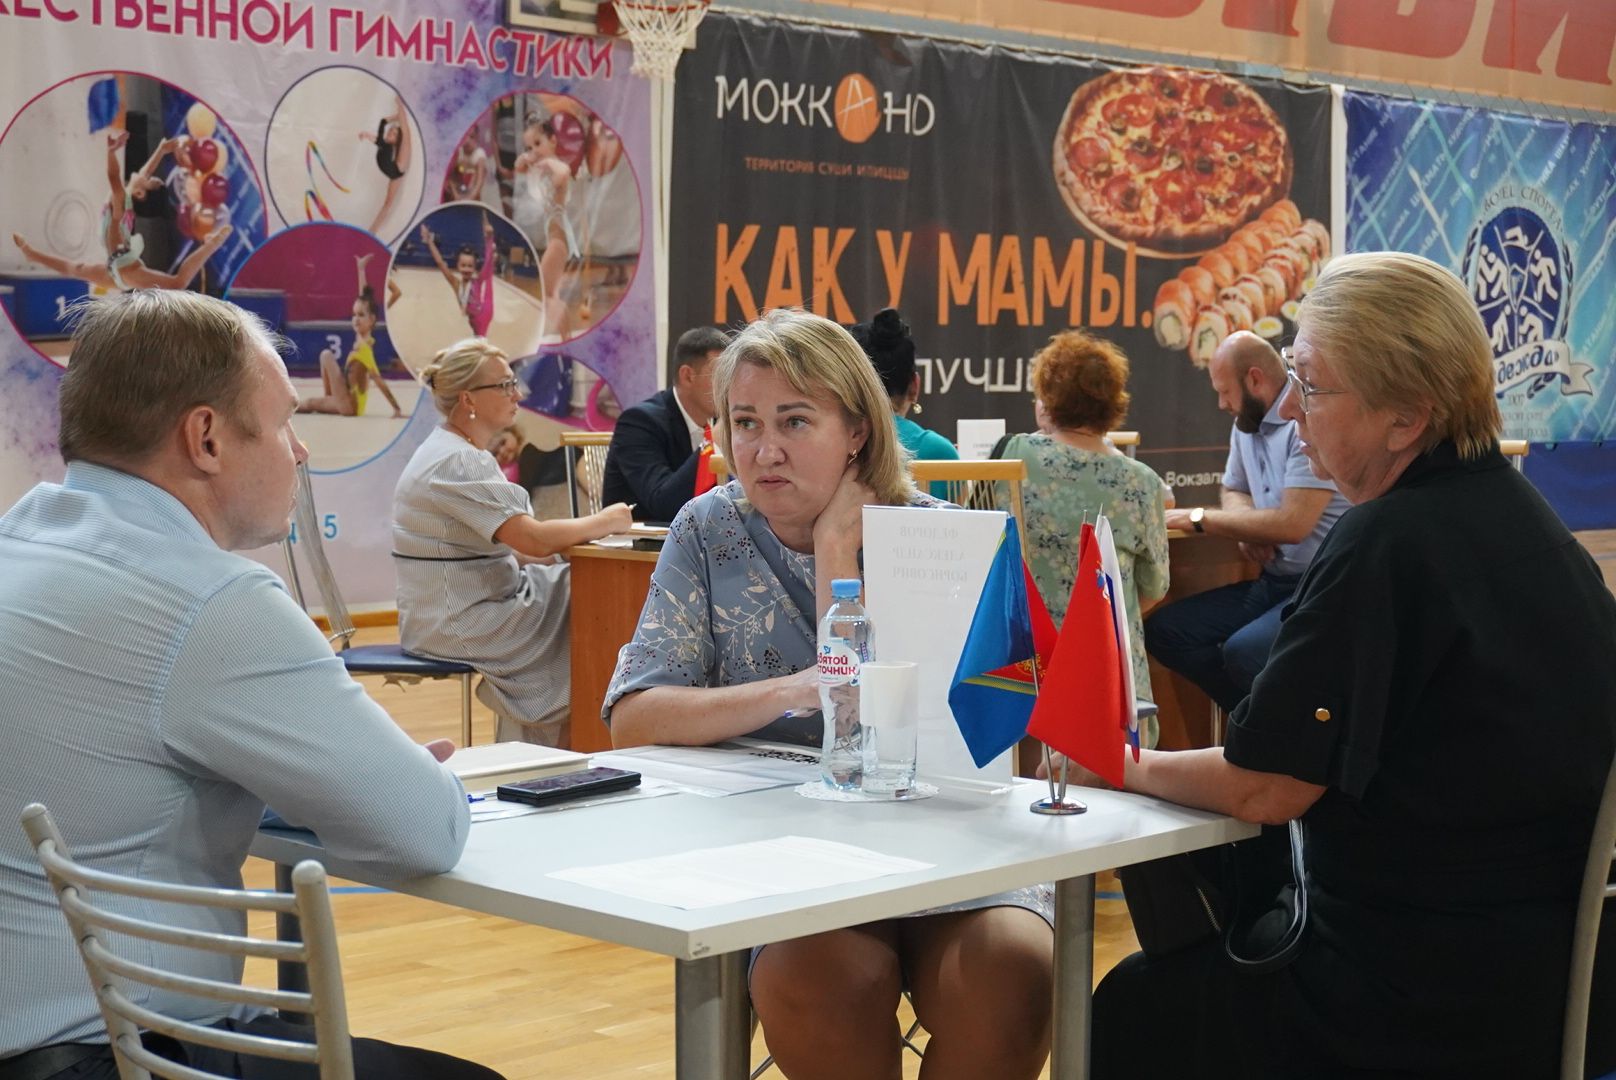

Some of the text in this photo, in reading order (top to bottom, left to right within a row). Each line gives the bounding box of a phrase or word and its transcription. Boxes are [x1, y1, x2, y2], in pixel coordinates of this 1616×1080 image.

[329, 8, 614, 79] ГИМНАСТИКИ
[714, 223, 1153, 328] КАК У МАМЫ.
[326, 334, 341, 360] 3
[1497, 345, 1560, 385] дежда»
[1165, 471, 1226, 487] Вокзал
[324, 514, 337, 539] 5
